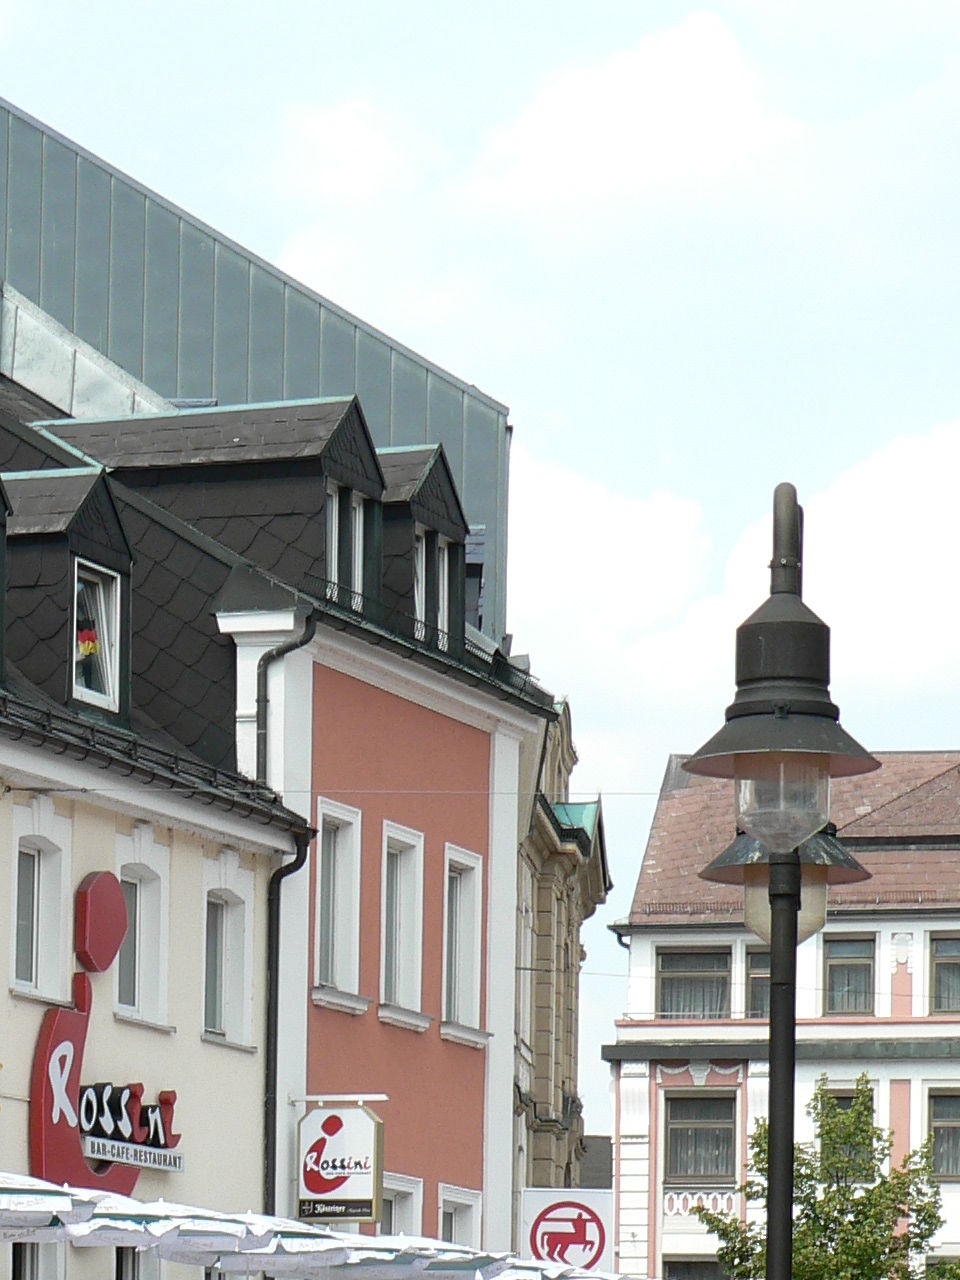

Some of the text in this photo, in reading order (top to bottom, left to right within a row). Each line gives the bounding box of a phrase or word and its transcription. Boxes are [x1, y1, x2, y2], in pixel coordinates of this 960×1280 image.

[48, 1040, 182, 1149] Rossini
[90, 1140, 182, 1169] BAR-CAFE-RESTAURANT
[305, 1152, 371, 1172] Rossini
